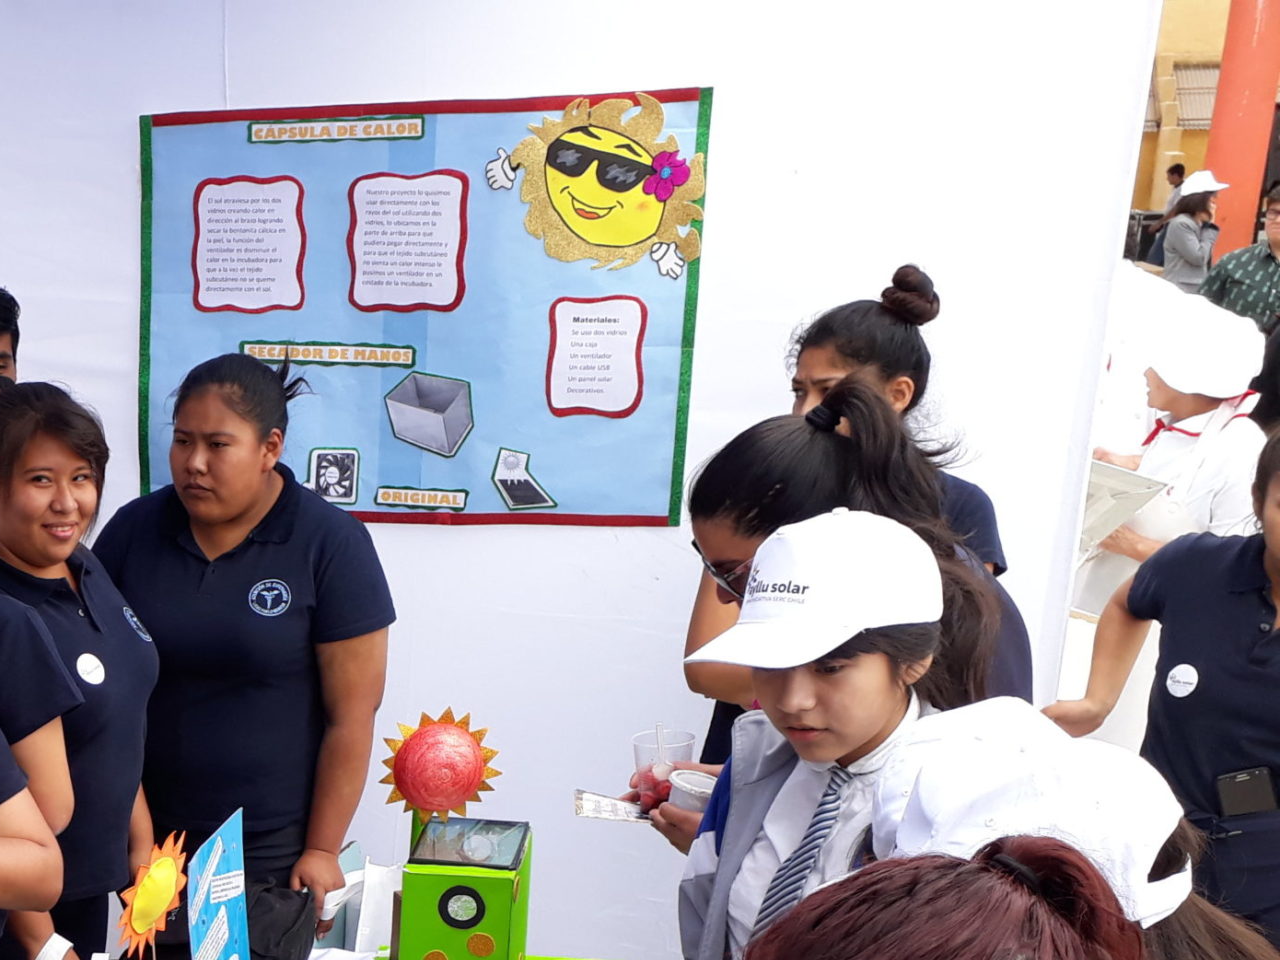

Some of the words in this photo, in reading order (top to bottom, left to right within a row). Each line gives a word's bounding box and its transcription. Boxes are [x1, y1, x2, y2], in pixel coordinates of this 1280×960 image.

[254, 124, 332, 140] CÁPSULA
[336, 125, 358, 137] DE
[362, 122, 419, 136] CALOR
[248, 346, 324, 359] SECADOR
[328, 348, 348, 360] DE
[353, 349, 411, 362] MANOS
[380, 491, 460, 505] ORIGINAL
[770, 580, 810, 594] solar
